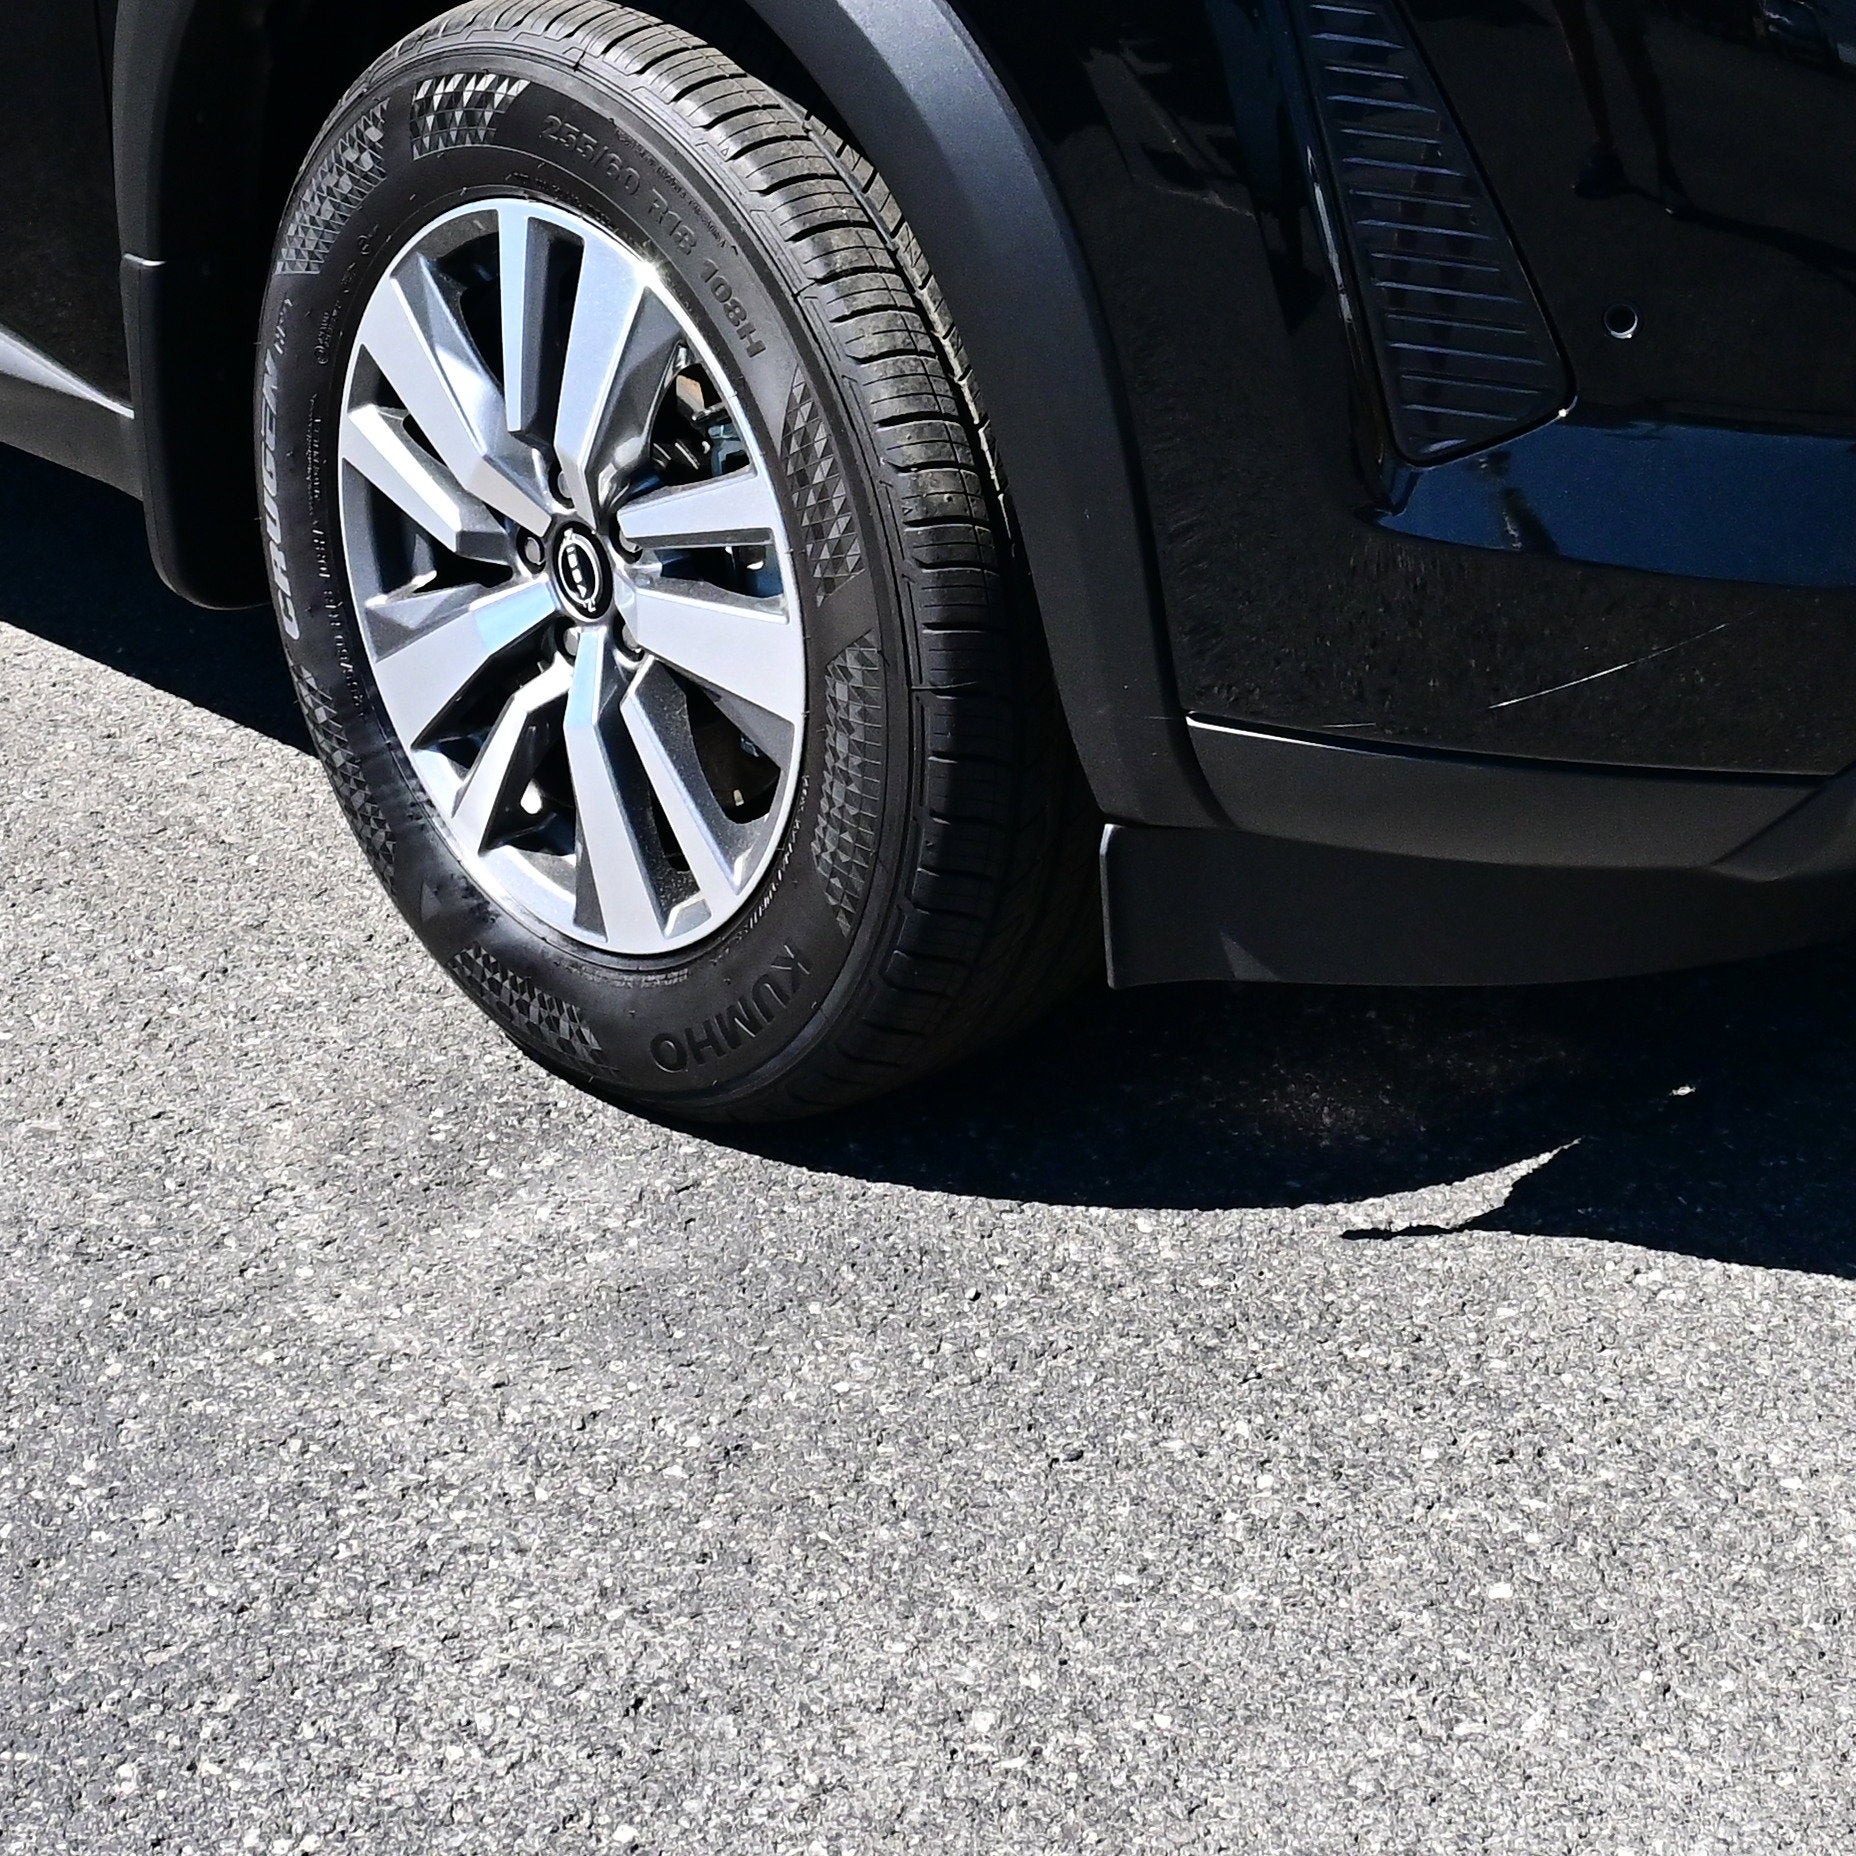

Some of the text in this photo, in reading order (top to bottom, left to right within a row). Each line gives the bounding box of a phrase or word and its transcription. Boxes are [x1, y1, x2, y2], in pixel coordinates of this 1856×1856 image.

[699, 257, 767, 359] 108H
[260, 348, 300, 641] CRUGEN
[649, 942, 811, 1075] KUMHO
